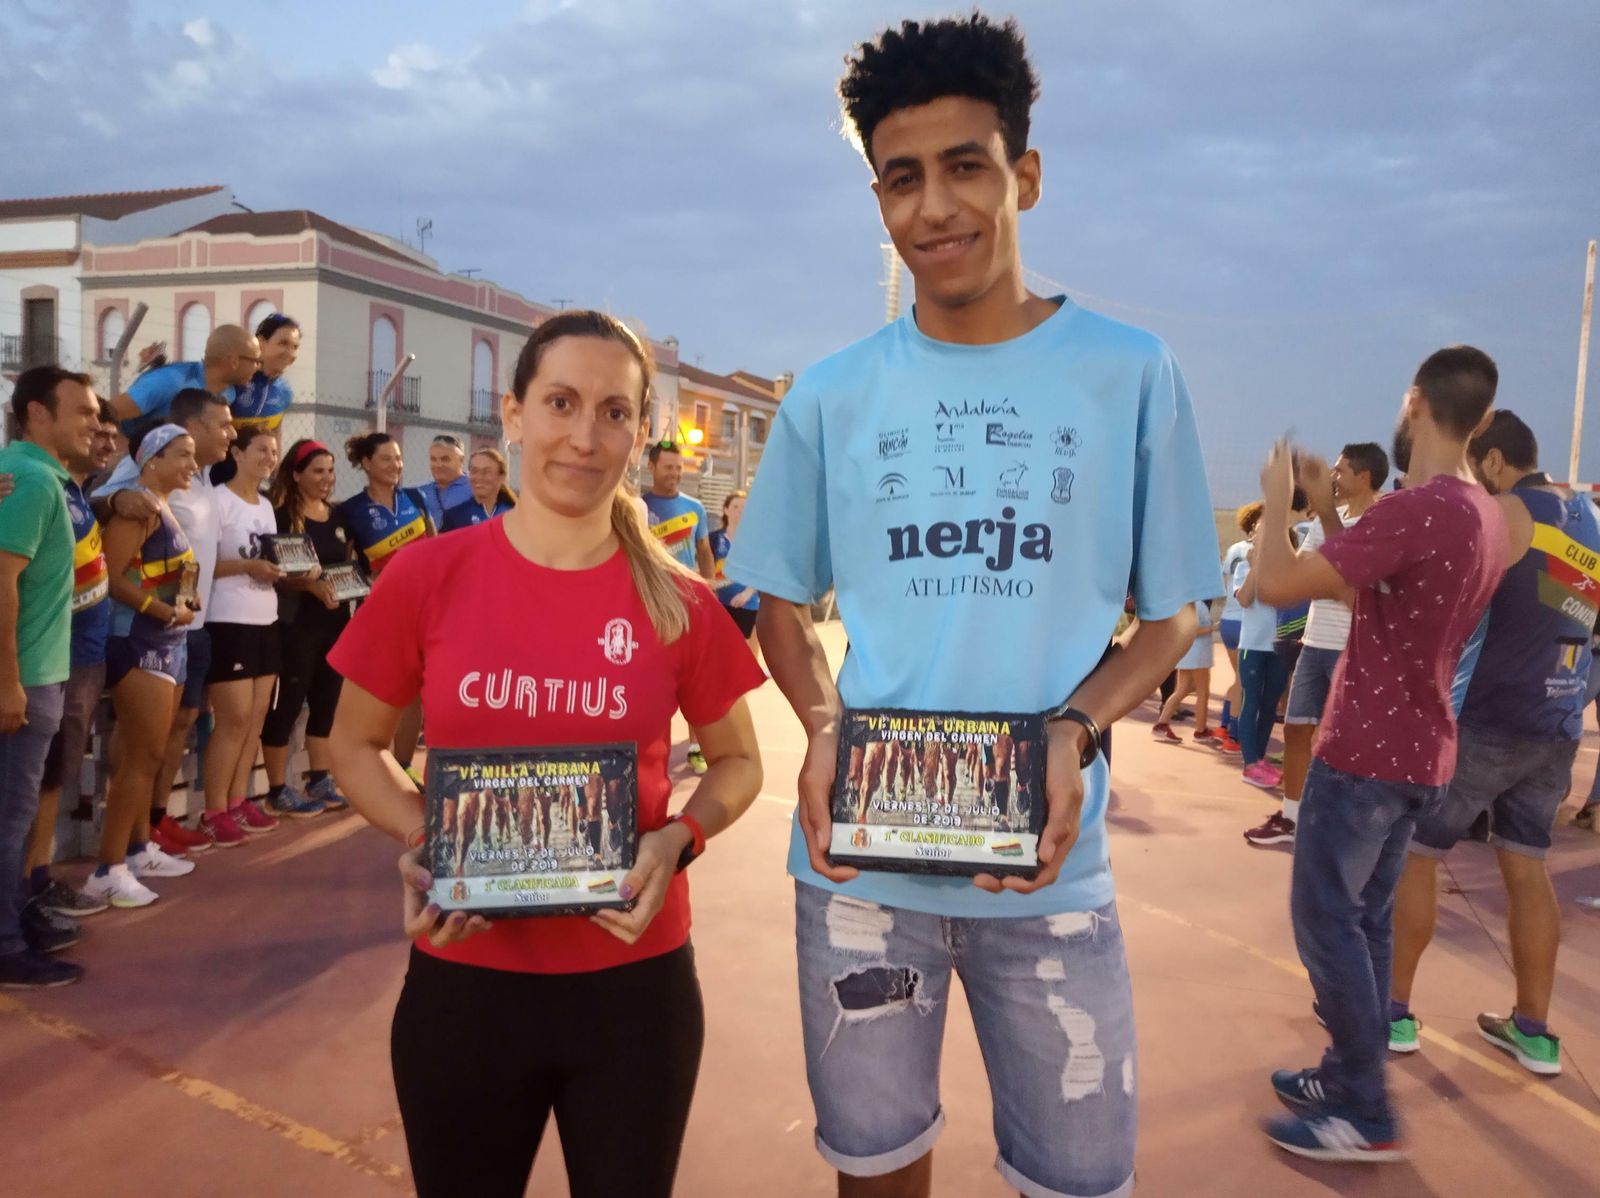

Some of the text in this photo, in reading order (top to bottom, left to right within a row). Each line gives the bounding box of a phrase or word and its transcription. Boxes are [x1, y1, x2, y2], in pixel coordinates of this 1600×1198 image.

[935, 397, 1020, 419] Andalucía
[389, 527, 415, 547] CLUB
[887, 506, 1053, 572] nerja
[1565, 544, 1598, 571] CLUB
[1561, 596, 1596, 628] CONIS
[458, 668, 628, 720] CURTIUS
[889, 716, 936, 733] MILLA
[943, 718, 1011, 735] URBANA
[881, 730, 998, 744] VIRGEN DEL CARMEN
[482, 763, 529, 779] MILLA
[536, 761, 600, 777] URBANA
[474, 775, 589, 789] VIRGEN DEL CARMEN
[872, 799, 1000, 816] VIERNES 12 DE JULIO
[913, 813, 962, 827] DE 2019
[470, 846, 595, 860] VIERNES 12 DE JULIO
[511, 859, 558, 871] DE 2019
